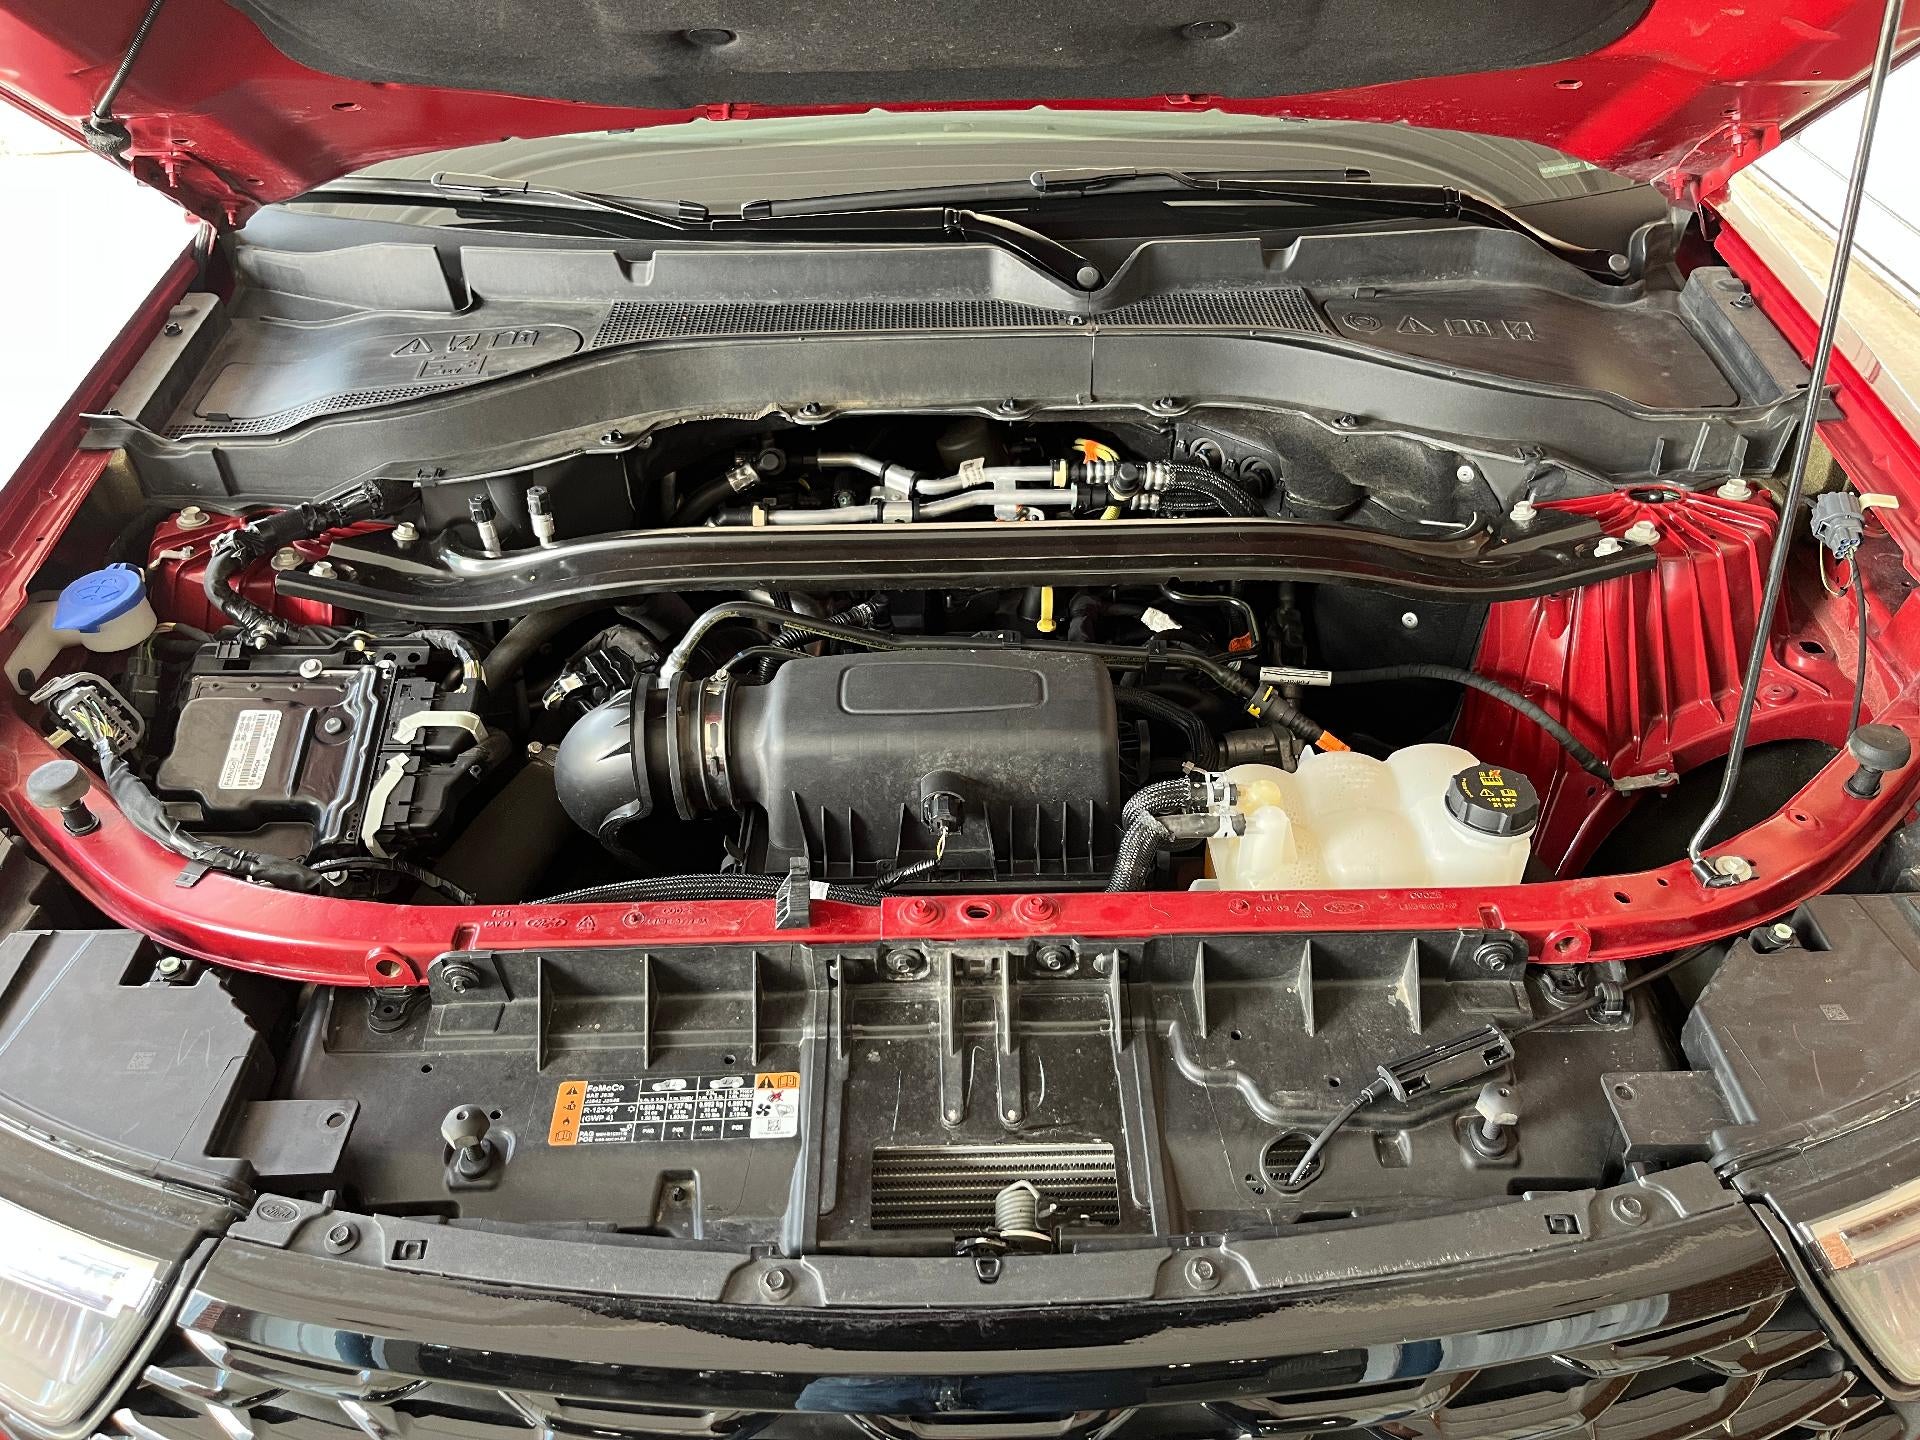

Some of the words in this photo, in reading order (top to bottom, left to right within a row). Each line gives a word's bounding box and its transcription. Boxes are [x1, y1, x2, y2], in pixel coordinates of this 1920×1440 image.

[251, 759, 261, 778] BOSCH
[586, 1083, 625, 1092] FoMoCo
[583, 1105, 619, 1114] R-1234yf
[581, 1114, 605, 1123] (GWP
[605, 1114, 614, 1122] 4)
